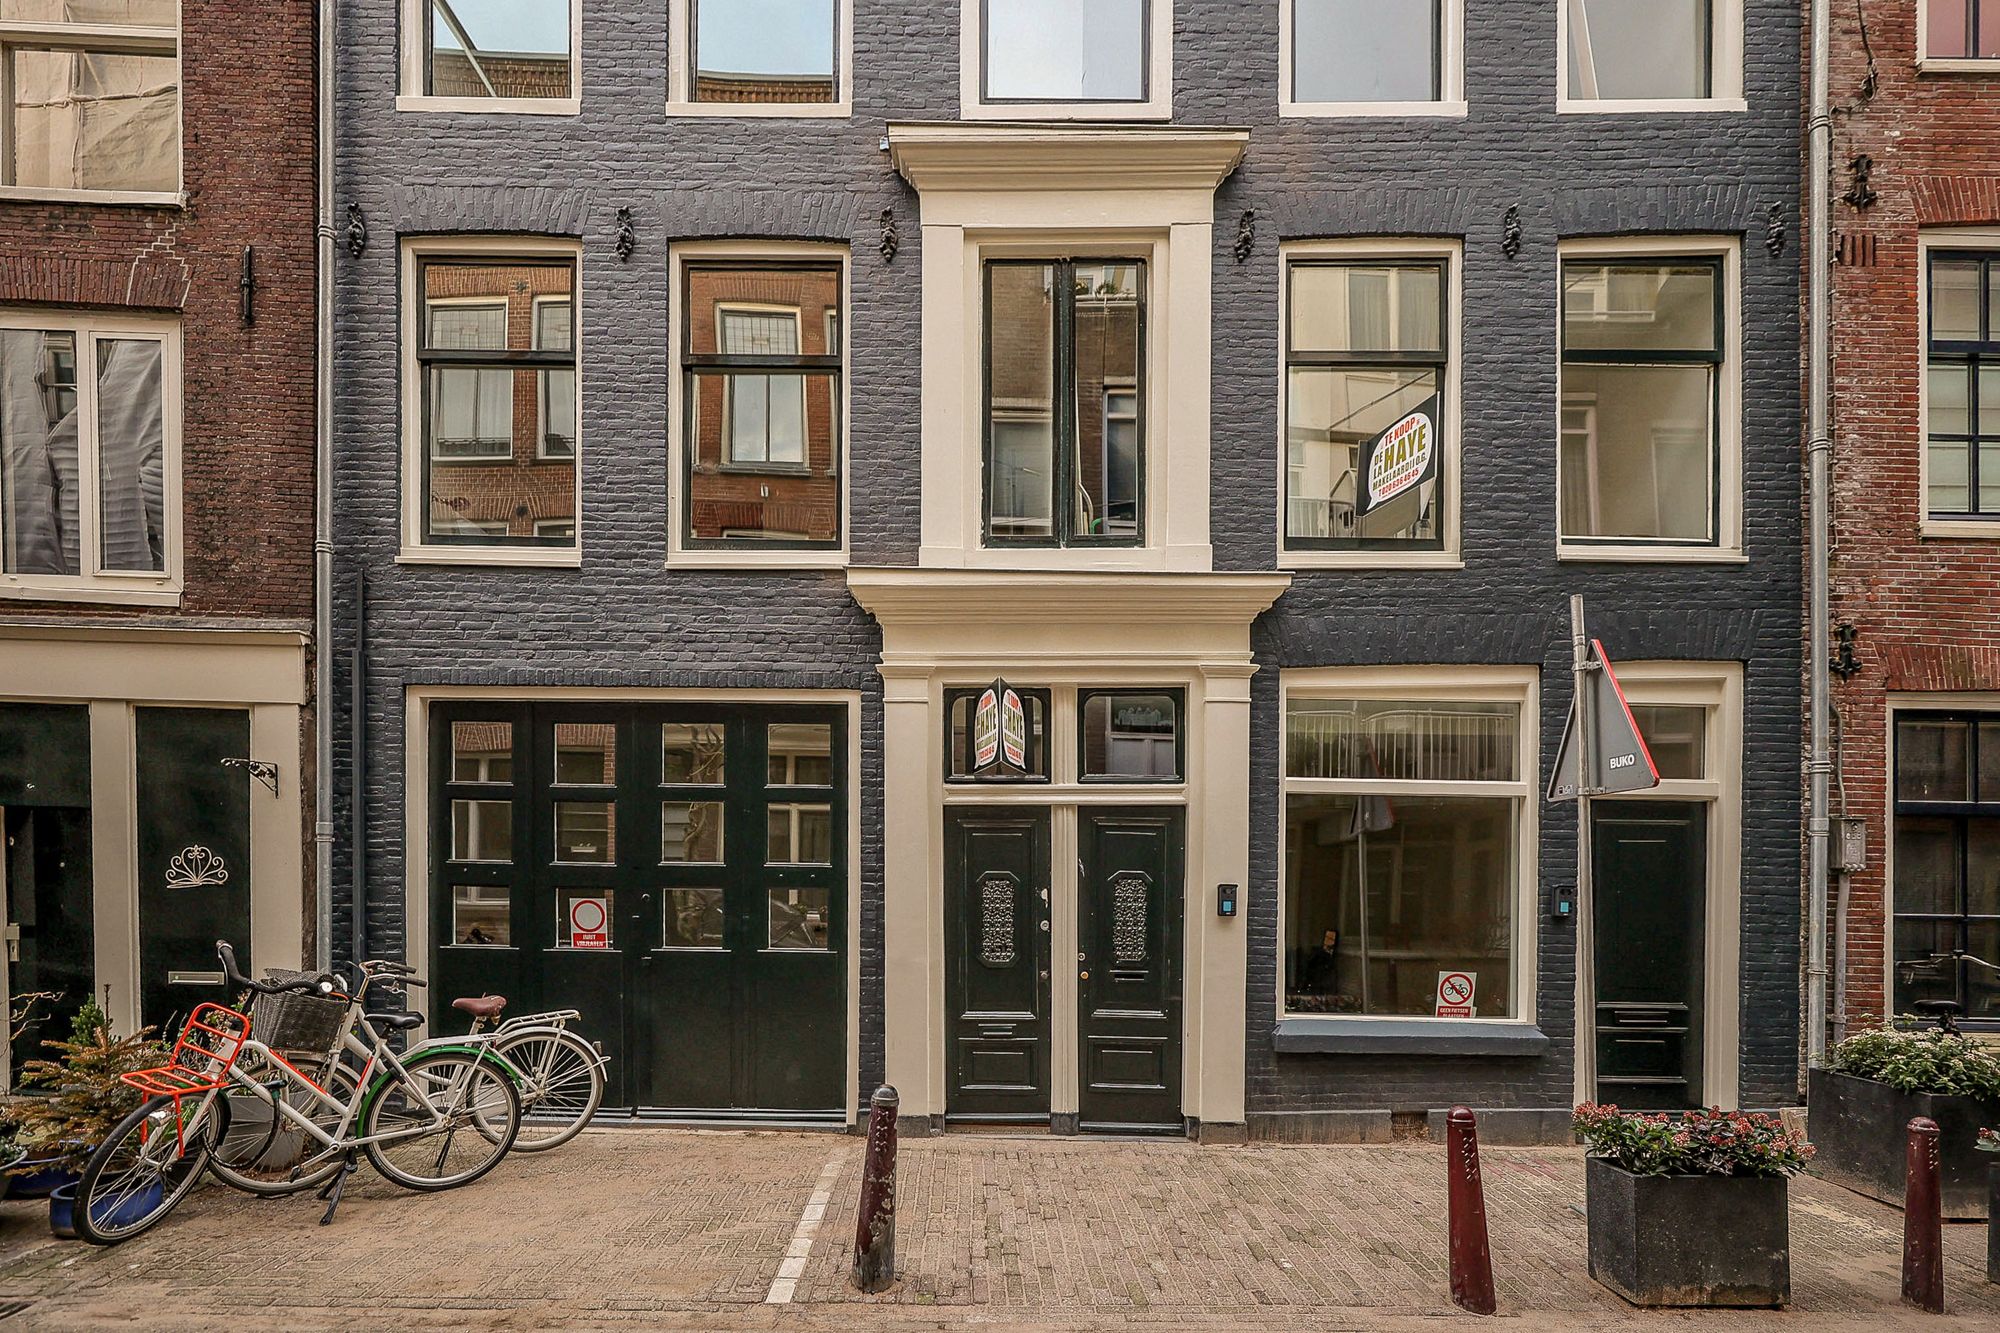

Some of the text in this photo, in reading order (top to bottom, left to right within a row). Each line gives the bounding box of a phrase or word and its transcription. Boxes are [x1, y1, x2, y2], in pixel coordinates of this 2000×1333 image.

[1385, 417, 1416, 446] TE KOOP
[1374, 451, 1384, 465] DE
[1384, 422, 1427, 474] HAYE
[1372, 460, 1415, 491] MAKELAARDIJ
[1373, 465, 1382, 479] LA
[1609, 754, 1635, 769] BUKO
